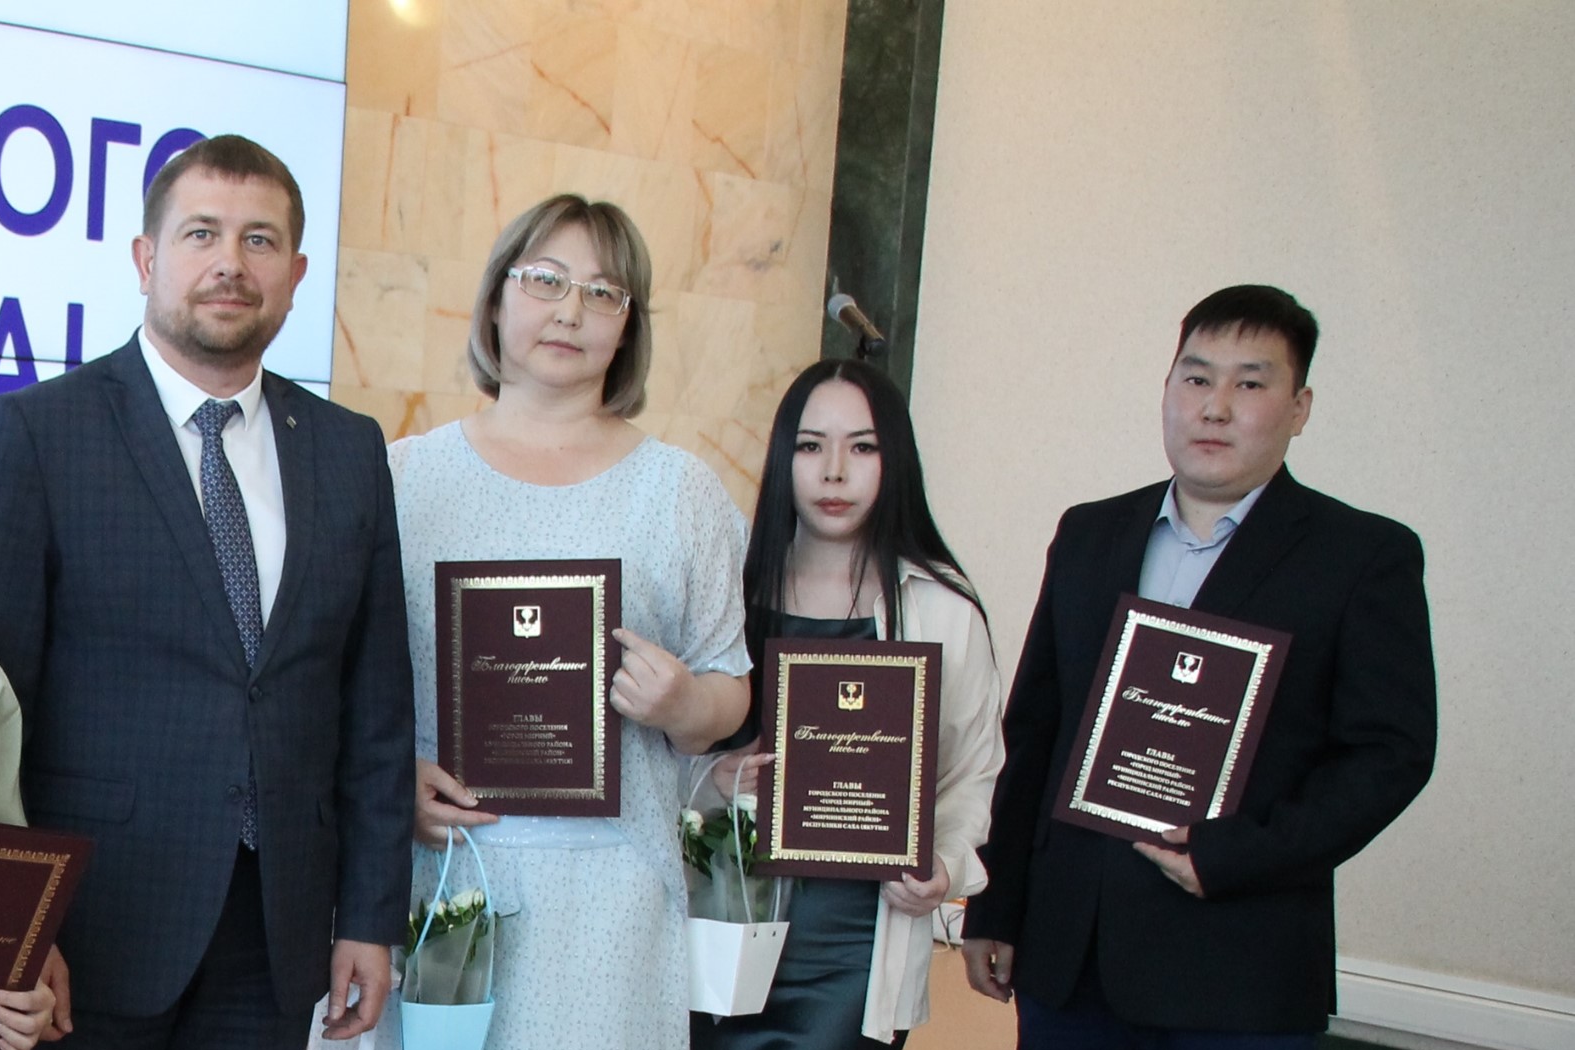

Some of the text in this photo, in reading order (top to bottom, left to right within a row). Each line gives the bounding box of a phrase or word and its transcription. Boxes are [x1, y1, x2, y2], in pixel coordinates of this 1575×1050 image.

[471, 655, 587, 676] Благодарственное
[507, 675, 548, 684] письмо
[1122, 686, 1230, 725] Благодарственное
[513, 714, 543, 723] ГЛАВЫ
[1151, 713, 1191, 727] письмо
[794, 725, 907, 745] Благодарственное
[829, 745, 869, 754] письмо
[1146, 747, 1175, 761] ГЛАВЫ
[833, 781, 862, 790] ГЛАВЫ
